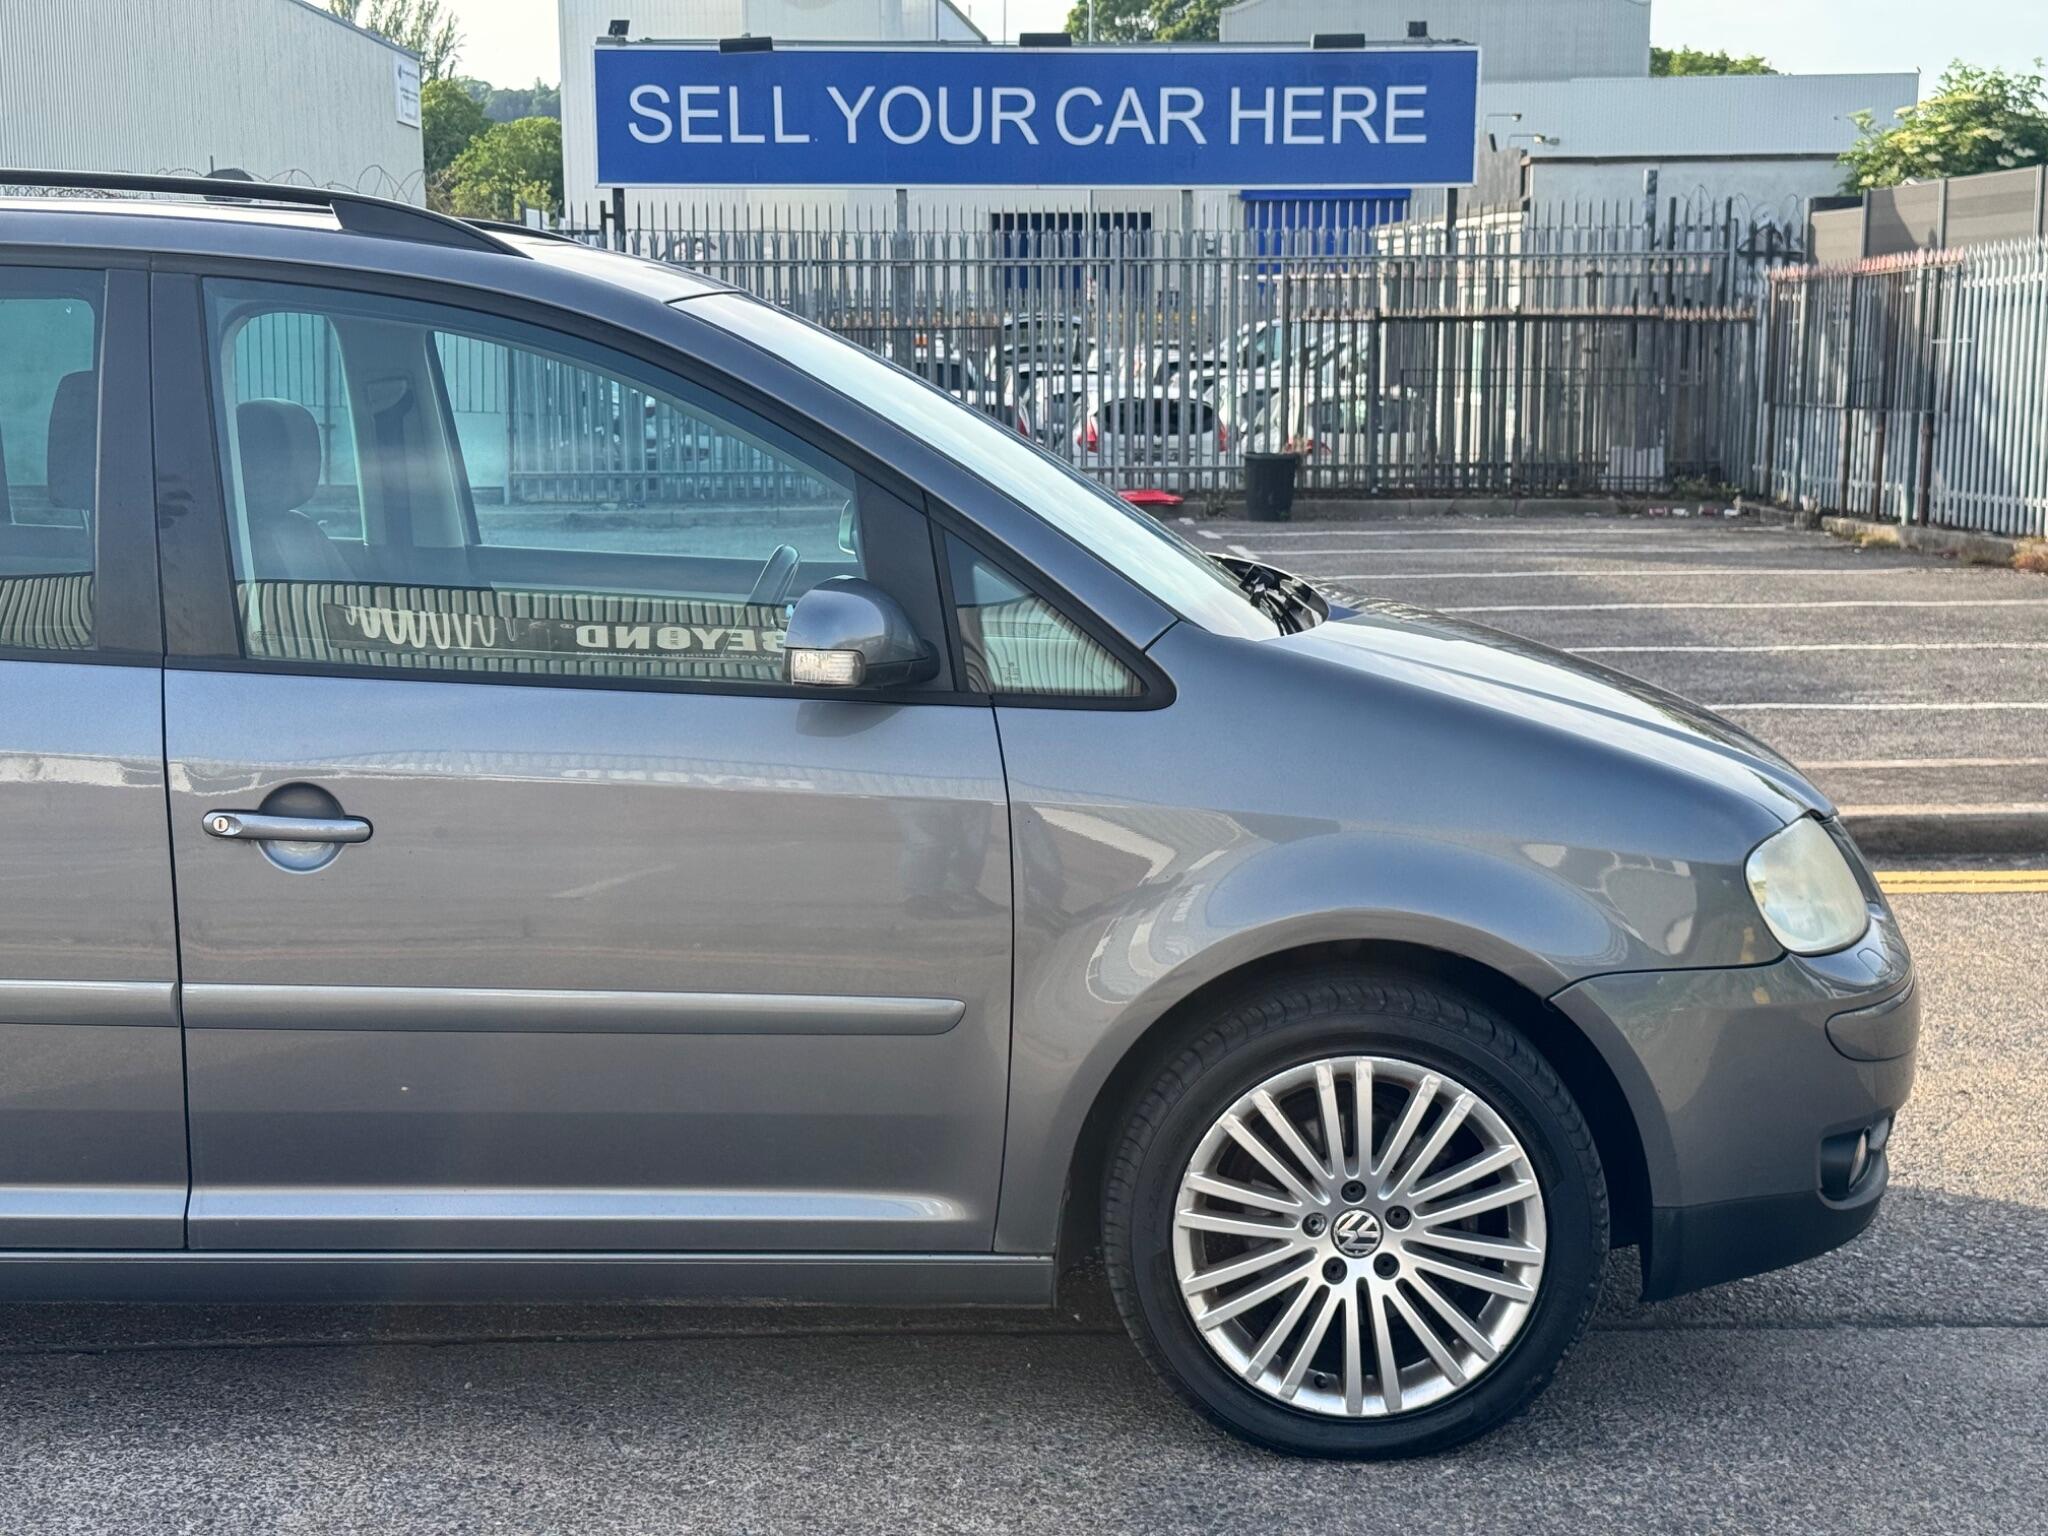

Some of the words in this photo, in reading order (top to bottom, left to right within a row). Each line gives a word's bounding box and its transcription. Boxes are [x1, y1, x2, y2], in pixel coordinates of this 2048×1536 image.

[627, 84, 810, 144] SELL
[827, 85, 1039, 145] YOUR
[1055, 86, 1207, 146] CAR
[1229, 86, 1428, 144] HERE
